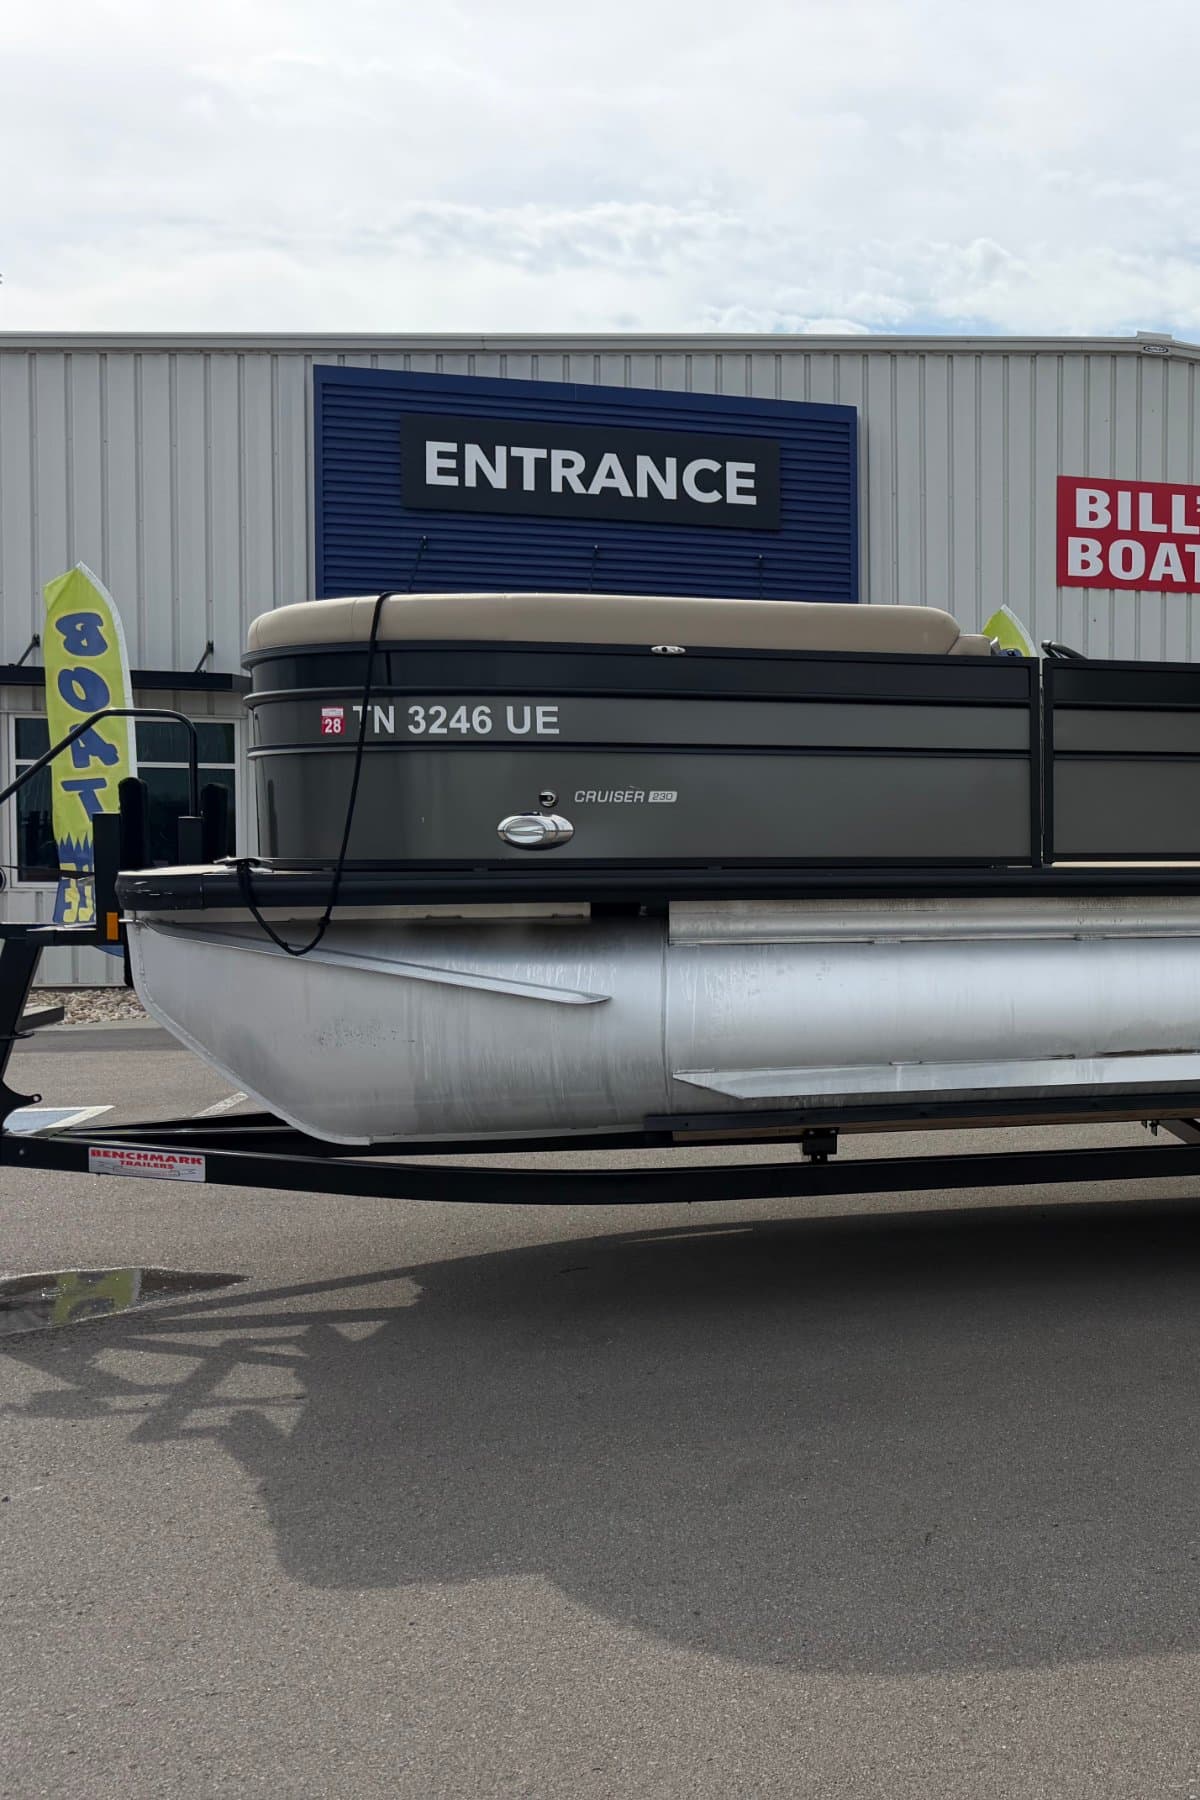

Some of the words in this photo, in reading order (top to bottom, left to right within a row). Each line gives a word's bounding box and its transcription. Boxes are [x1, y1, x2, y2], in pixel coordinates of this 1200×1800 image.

[425, 440, 757, 505] ENTRANCE
[324, 718, 342, 734] 28
[353, 705, 395, 734] TN
[407, 705, 493, 734] 3246
[506, 705, 560, 735] UE
[574, 790, 645, 803] CRUISER
[90, 1149, 203, 1165] BENCHMARK
[120, 1160, 175, 1170] TRAILERS
